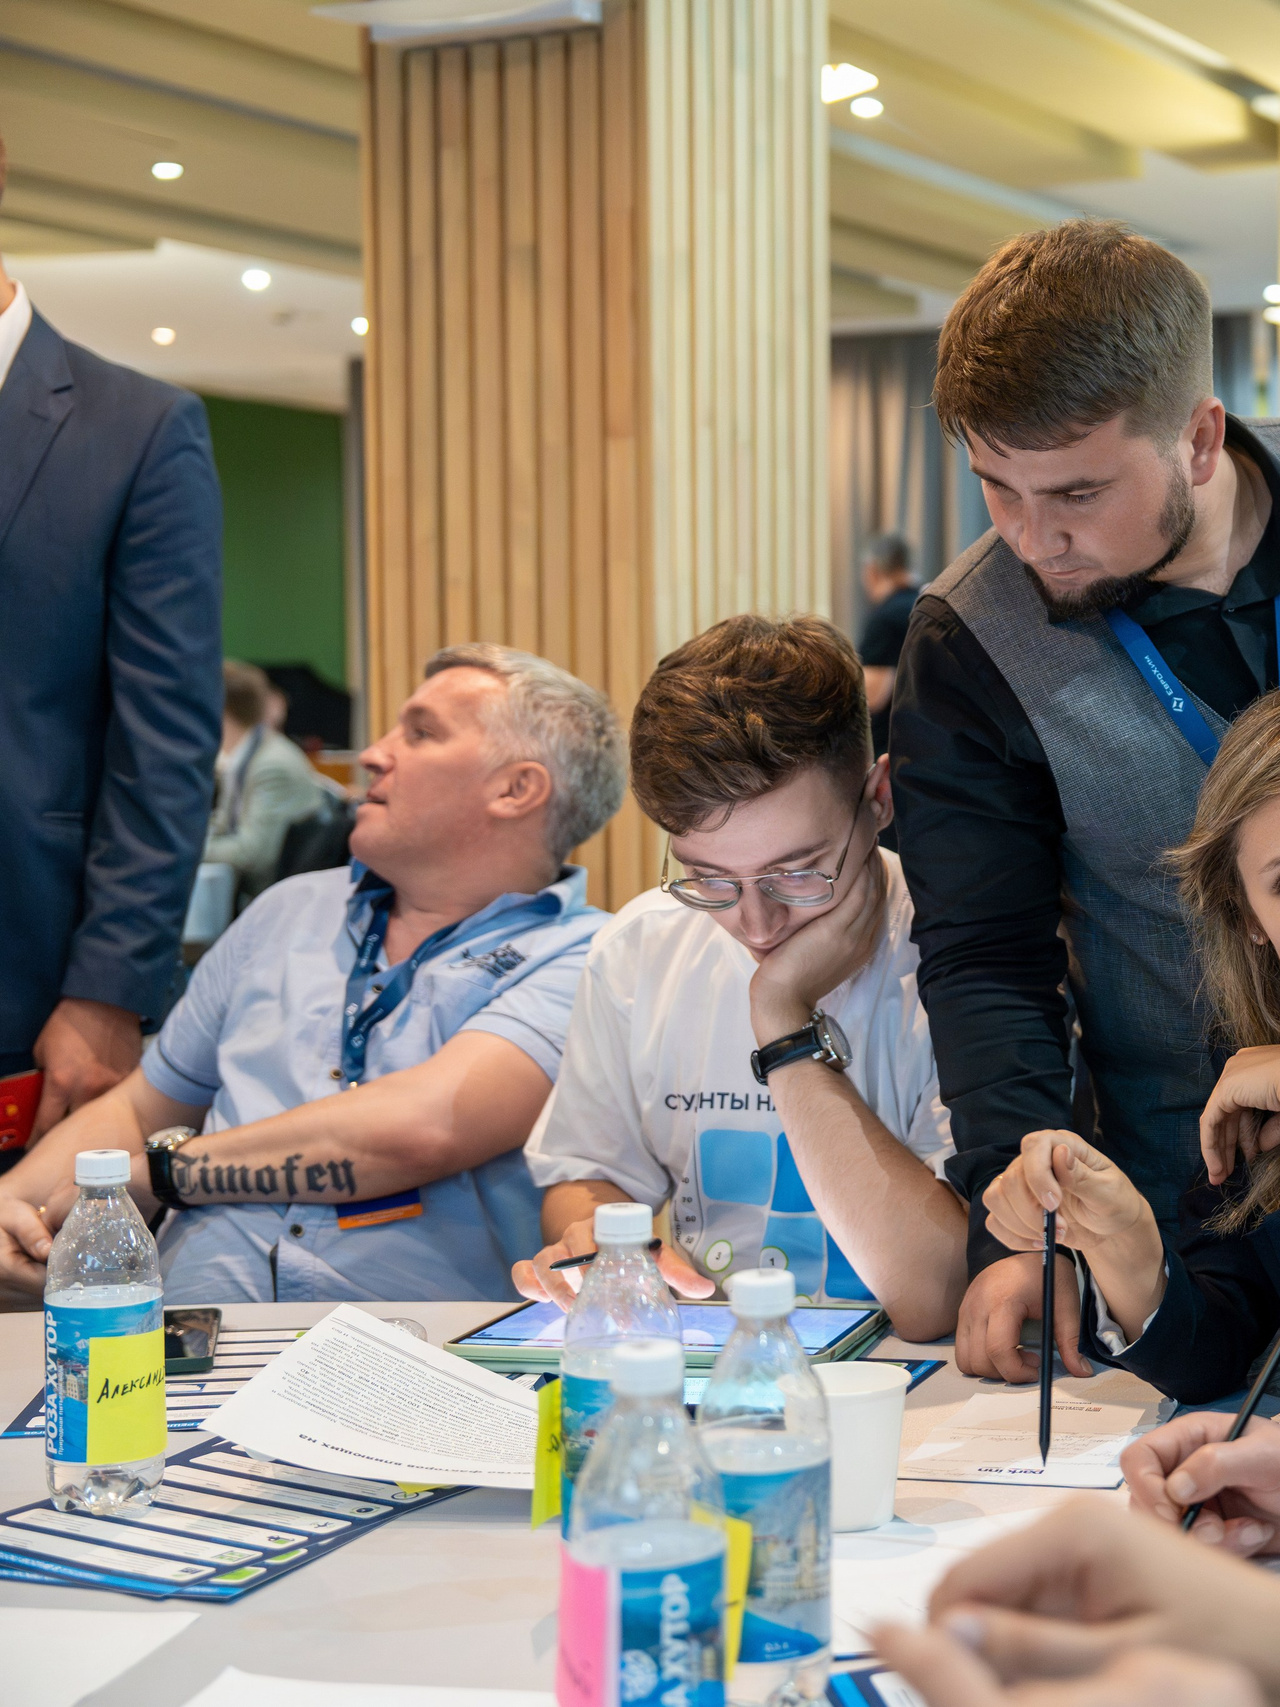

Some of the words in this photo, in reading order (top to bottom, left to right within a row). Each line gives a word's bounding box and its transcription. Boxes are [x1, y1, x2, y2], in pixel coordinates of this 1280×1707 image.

[1144, 655, 1174, 697] ЕВРОХИМ
[757, 1094, 777, 1112] Н
[172, 1152, 357, 1197] Timofey
[769, 1257, 775, 1266] 1
[45, 1310, 58, 1388] ХУТОР
[46, 1393, 58, 1455] РОЗА
[977, 1467, 1003, 1475] inn
[1007, 1467, 1045, 1476] park
